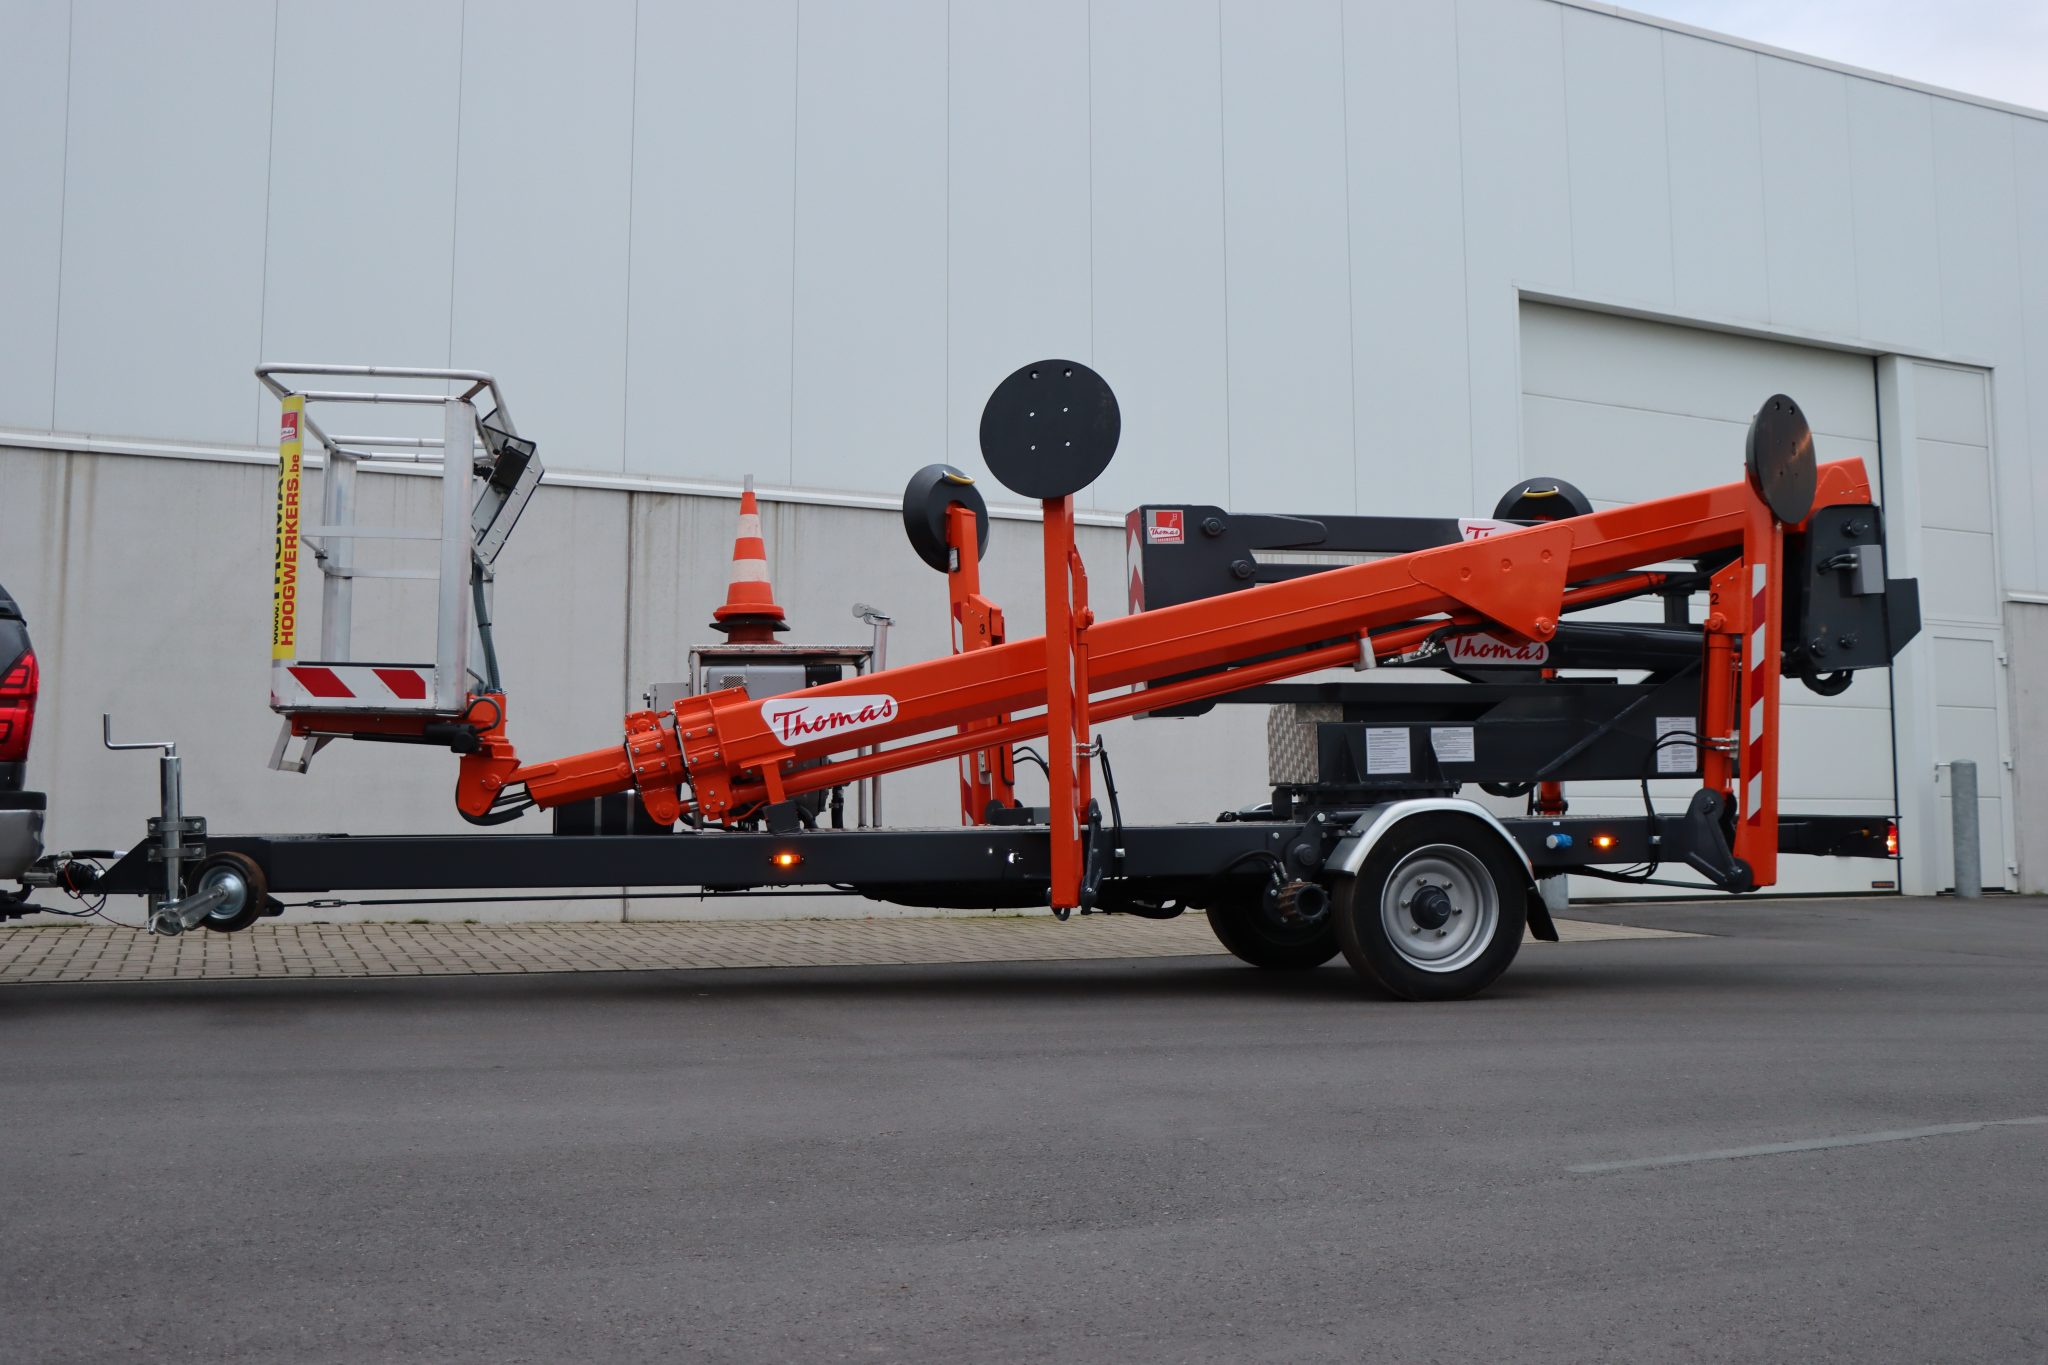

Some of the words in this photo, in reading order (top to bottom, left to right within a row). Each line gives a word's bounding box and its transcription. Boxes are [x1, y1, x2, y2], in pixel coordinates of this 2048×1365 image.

[281, 454, 300, 646] HOOGWERKERS.be
[1711, 592, 1720, 605] 2
[979, 623, 986, 635] 3
[1440, 632, 1544, 660] Thomas
[773, 699, 892, 740] Thomas
